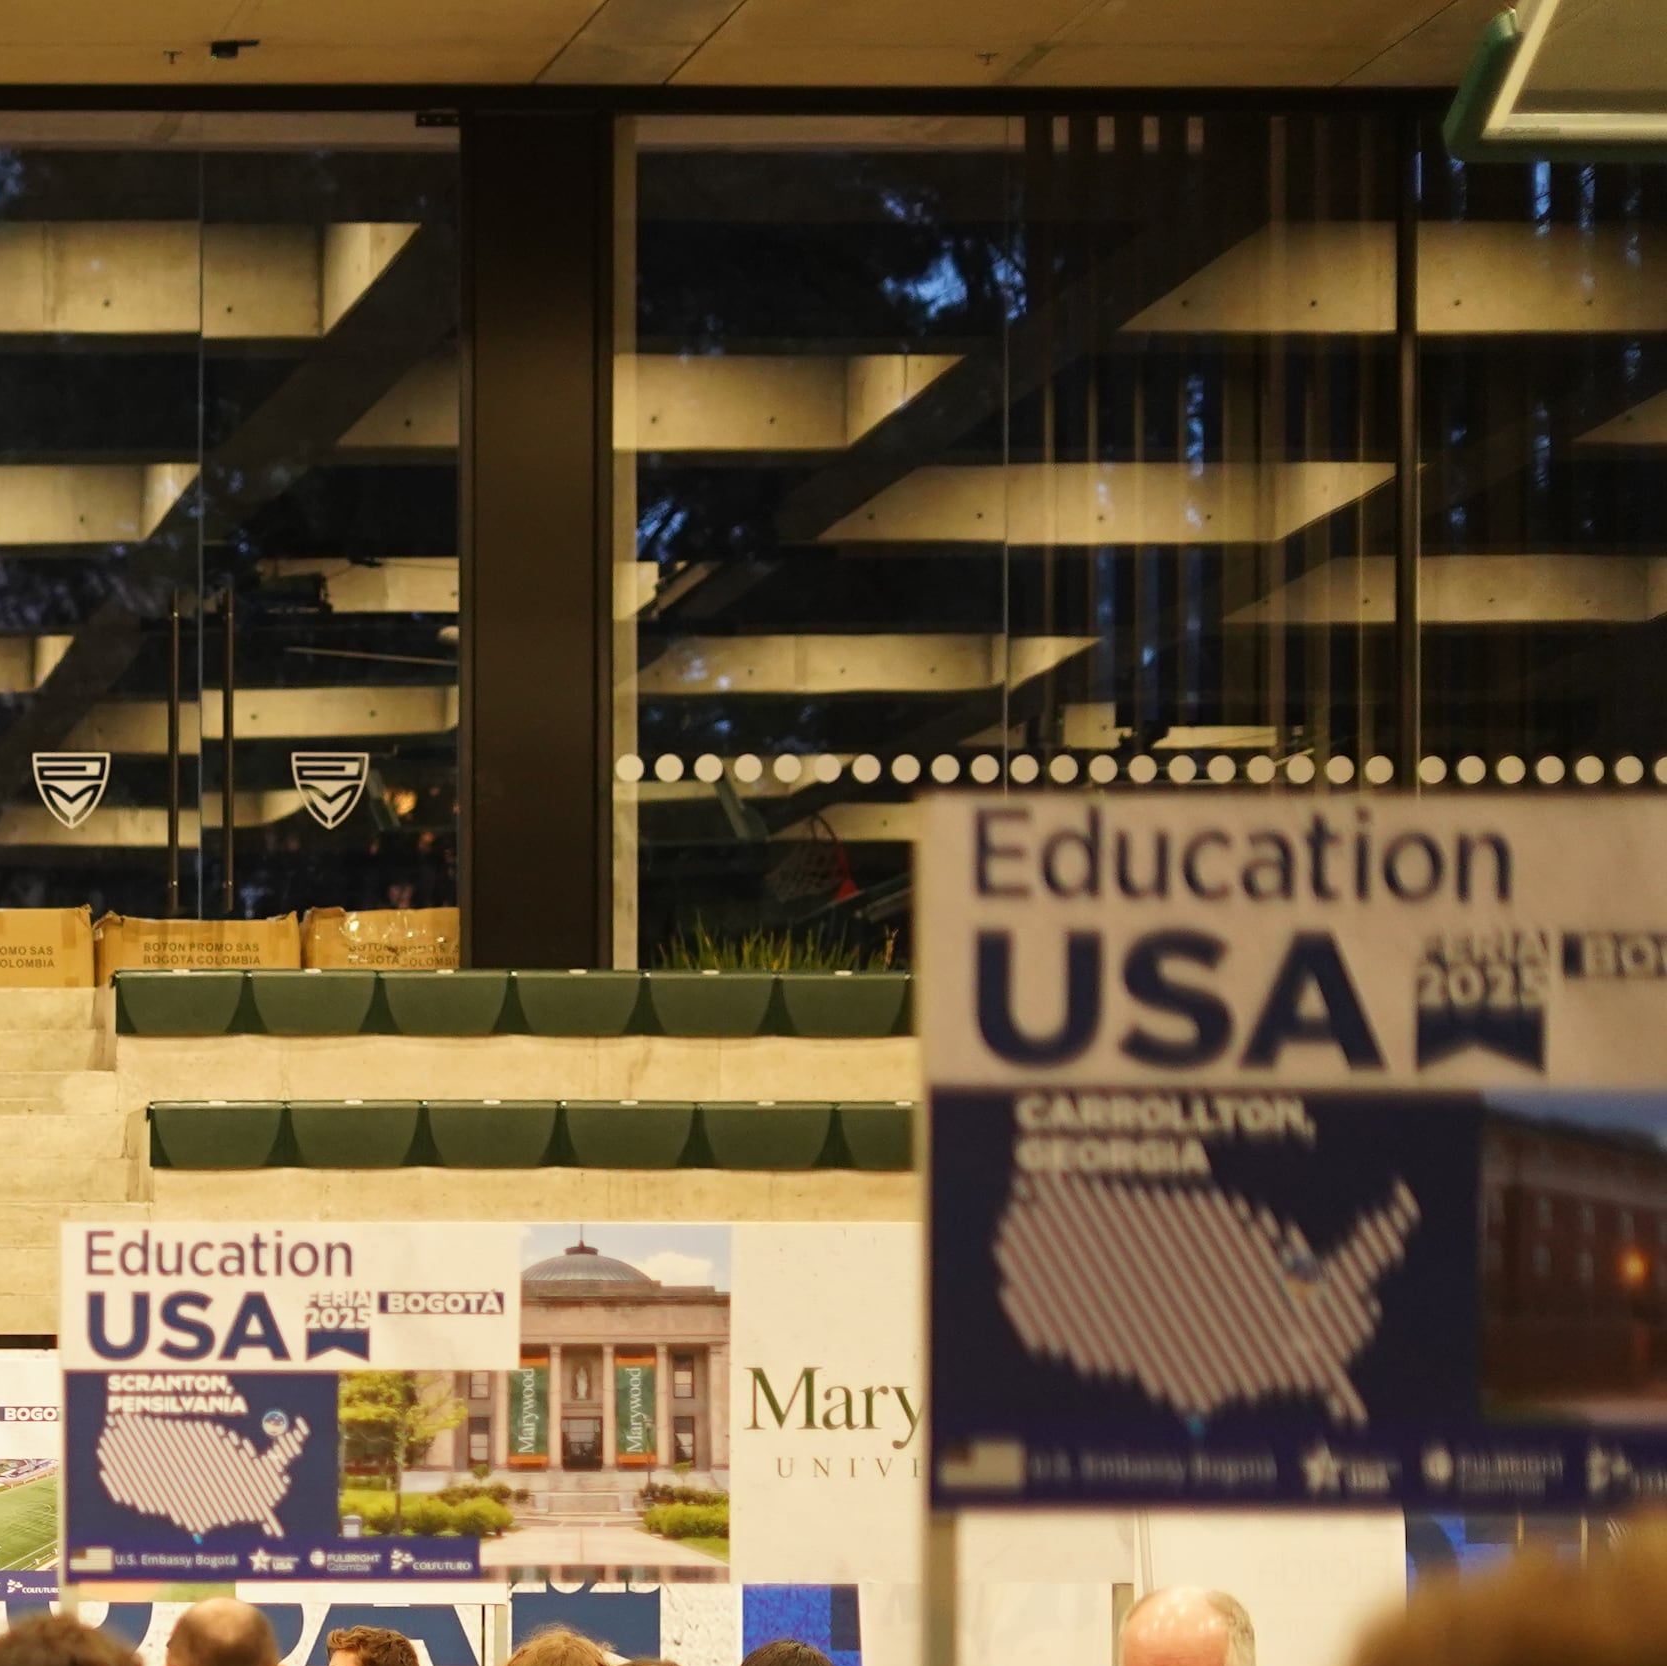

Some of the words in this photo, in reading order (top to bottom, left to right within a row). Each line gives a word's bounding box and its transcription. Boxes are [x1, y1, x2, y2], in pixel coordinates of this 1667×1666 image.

[973, 805, 1514, 902] Education
[29, 946, 53, 955] SAS
[189, 942, 233, 952] PROMO
[236, 942, 259, 952] SAS
[197, 955, 260, 965] COLOMBIA
[975, 928, 1385, 1073] USA
[1016, 1097, 1317, 1146] CARROLLTON,
[1016, 1138, 1210, 1174] GEORGIA
[86, 1230, 353, 1277] Education
[305, 1290, 370, 1308] FERIA
[387, 1289, 500, 1314] BOGOTÁ
[87, 1290, 292, 1362] USA
[305, 1308, 370, 1330] 2025
[107, 1375, 233, 1395] SCRANTON,
[4, 1406, 61, 1421] BOGO
[107, 1396, 248, 1414] PENSILVANIA
[518, 1367, 537, 1454] Marywood
[626, 1367, 643, 1454] Marywood
[141, 1554, 192, 1569] Embassy
[195, 1553, 238, 1569] Bogotá
